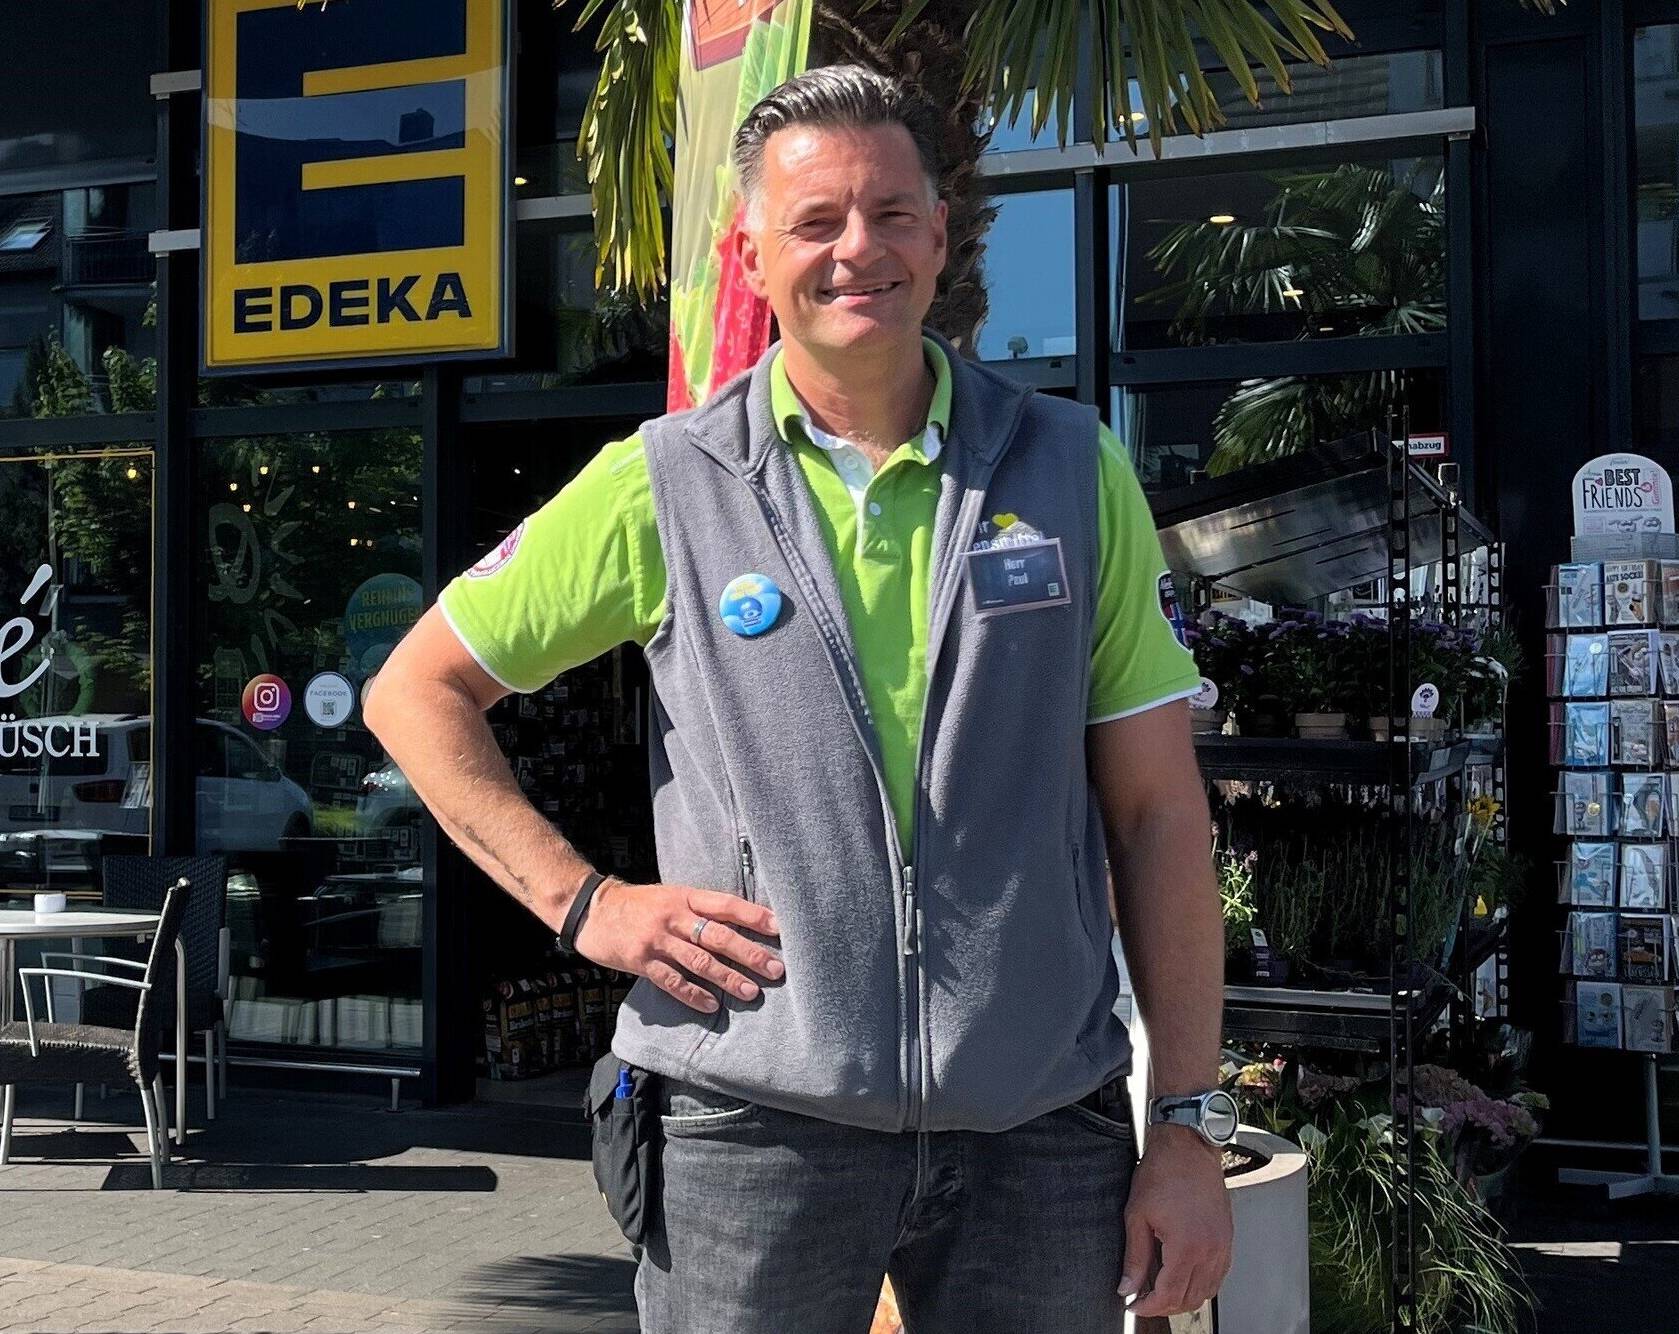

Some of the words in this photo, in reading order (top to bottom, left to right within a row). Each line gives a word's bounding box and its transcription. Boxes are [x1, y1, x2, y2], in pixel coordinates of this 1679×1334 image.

[233, 272, 472, 334] EDEKA
[1604, 468, 1640, 486] BEST
[1582, 478, 1643, 509] FRIENDS
